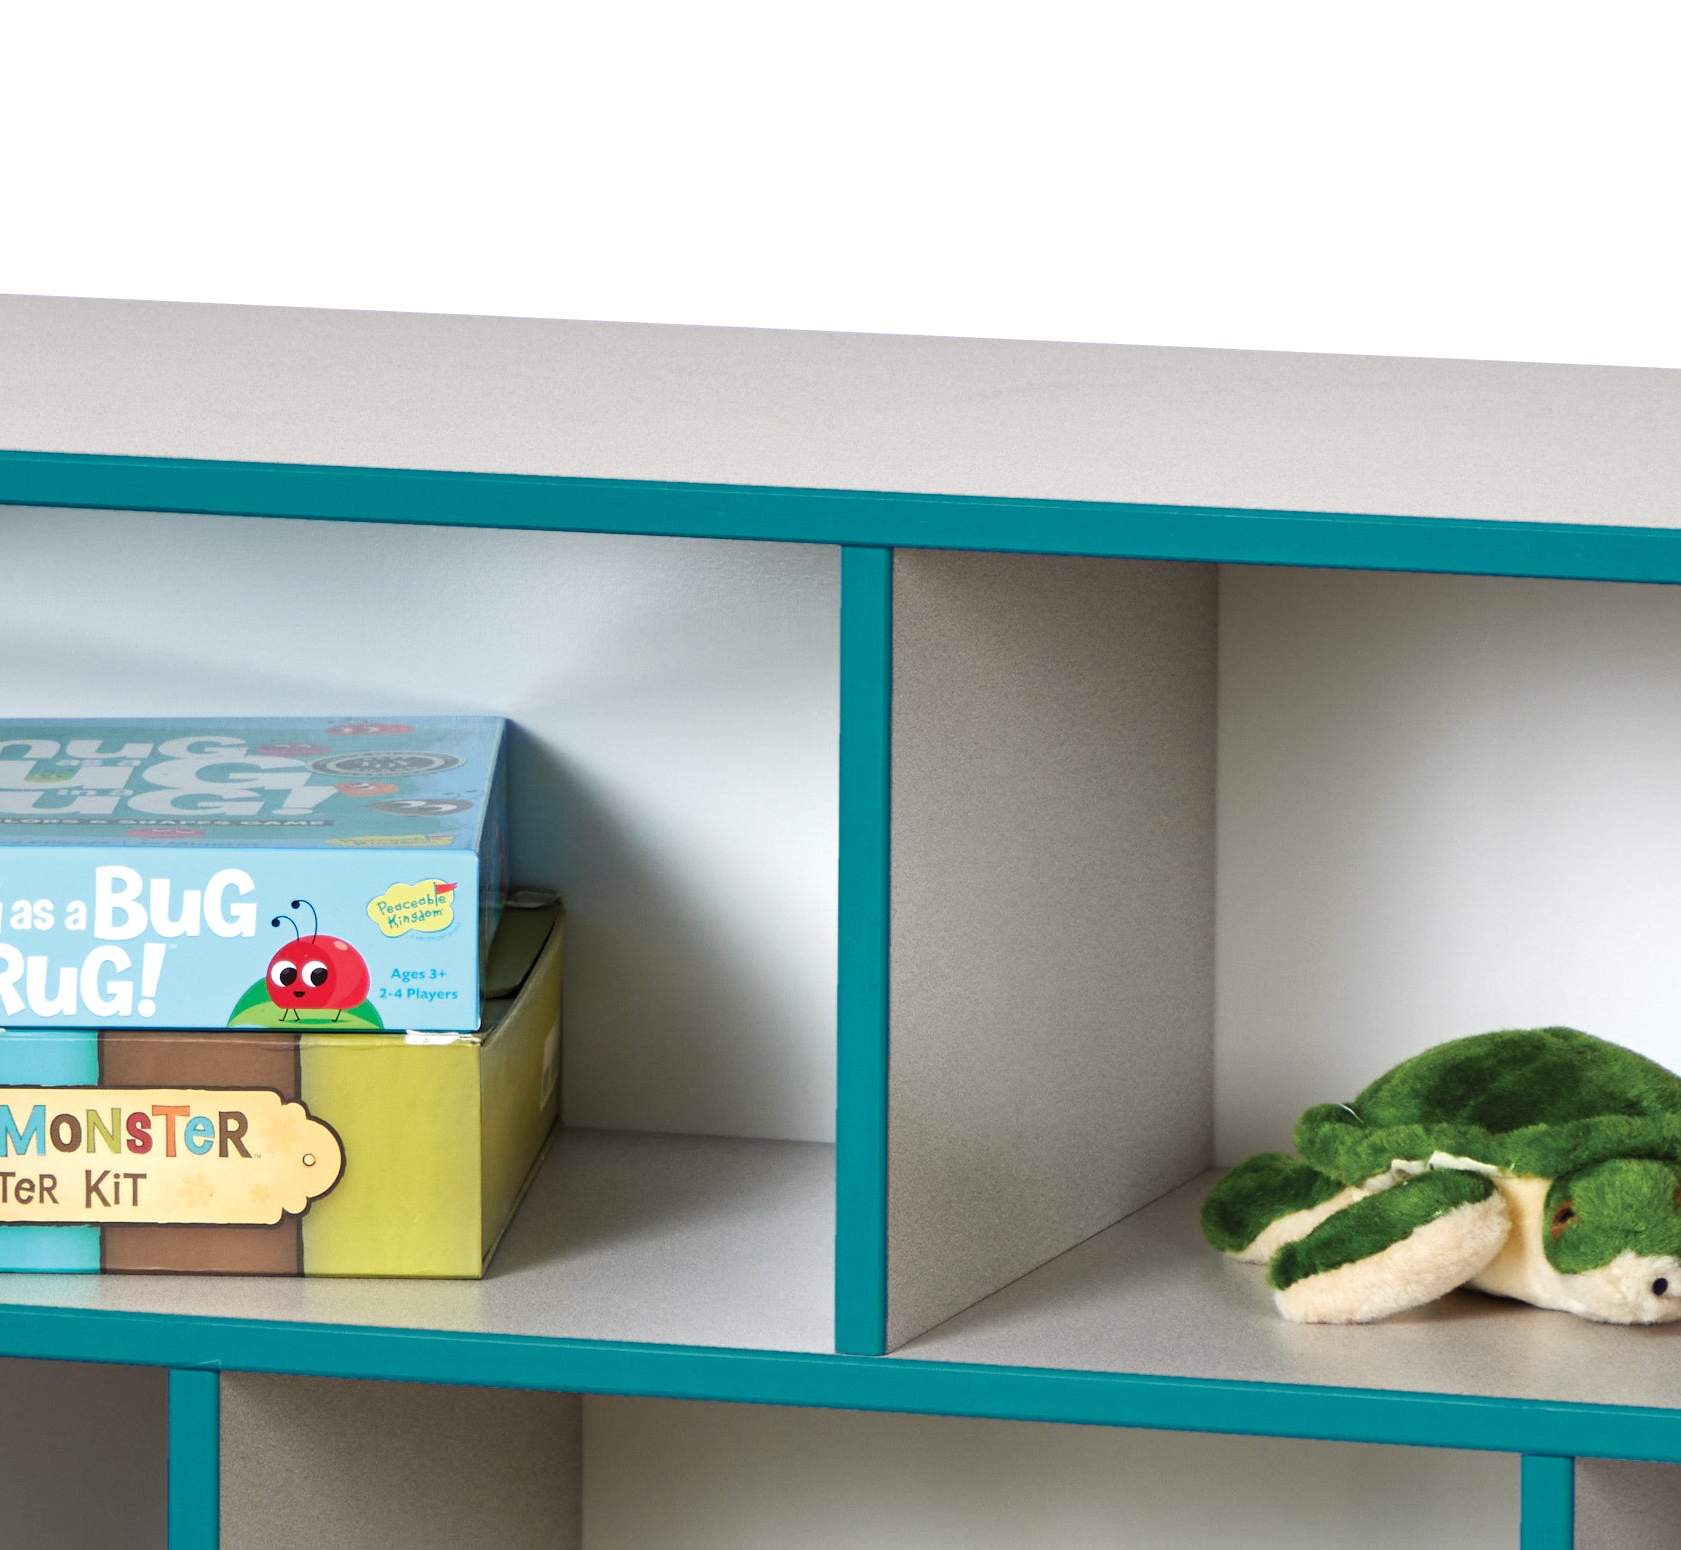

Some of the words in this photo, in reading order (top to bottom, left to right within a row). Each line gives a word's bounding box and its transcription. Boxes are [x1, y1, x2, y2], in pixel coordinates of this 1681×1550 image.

[377, 886, 446, 915] Peaceable
[9, 898, 56, 931] as
[64, 898, 88, 931] a
[388, 909, 443, 929] Kingdom
[390, 968, 425, 982] Ages
[429, 968, 447, 979] 3+
[379, 988, 402, 999] 2-4
[407, 987, 458, 1002] Players
